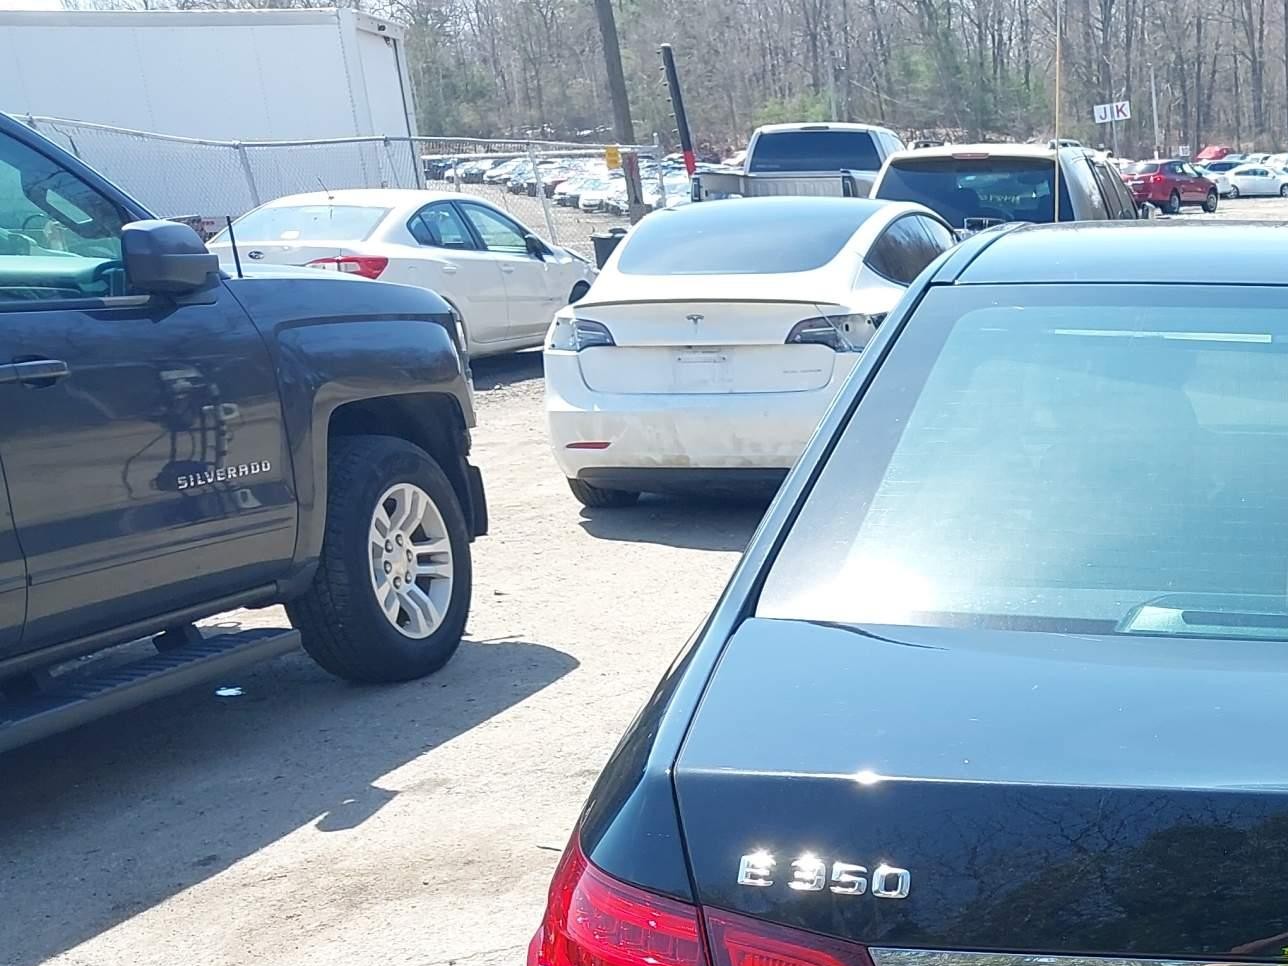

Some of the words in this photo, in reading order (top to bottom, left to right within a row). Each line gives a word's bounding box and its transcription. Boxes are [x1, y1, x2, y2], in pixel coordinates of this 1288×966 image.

[1099, 106, 1107, 121] J
[1115, 103, 1128, 118] K
[177, 460, 271, 489] SILVERADO
[737, 850, 776, 887] E
[787, 853, 911, 899] 350
